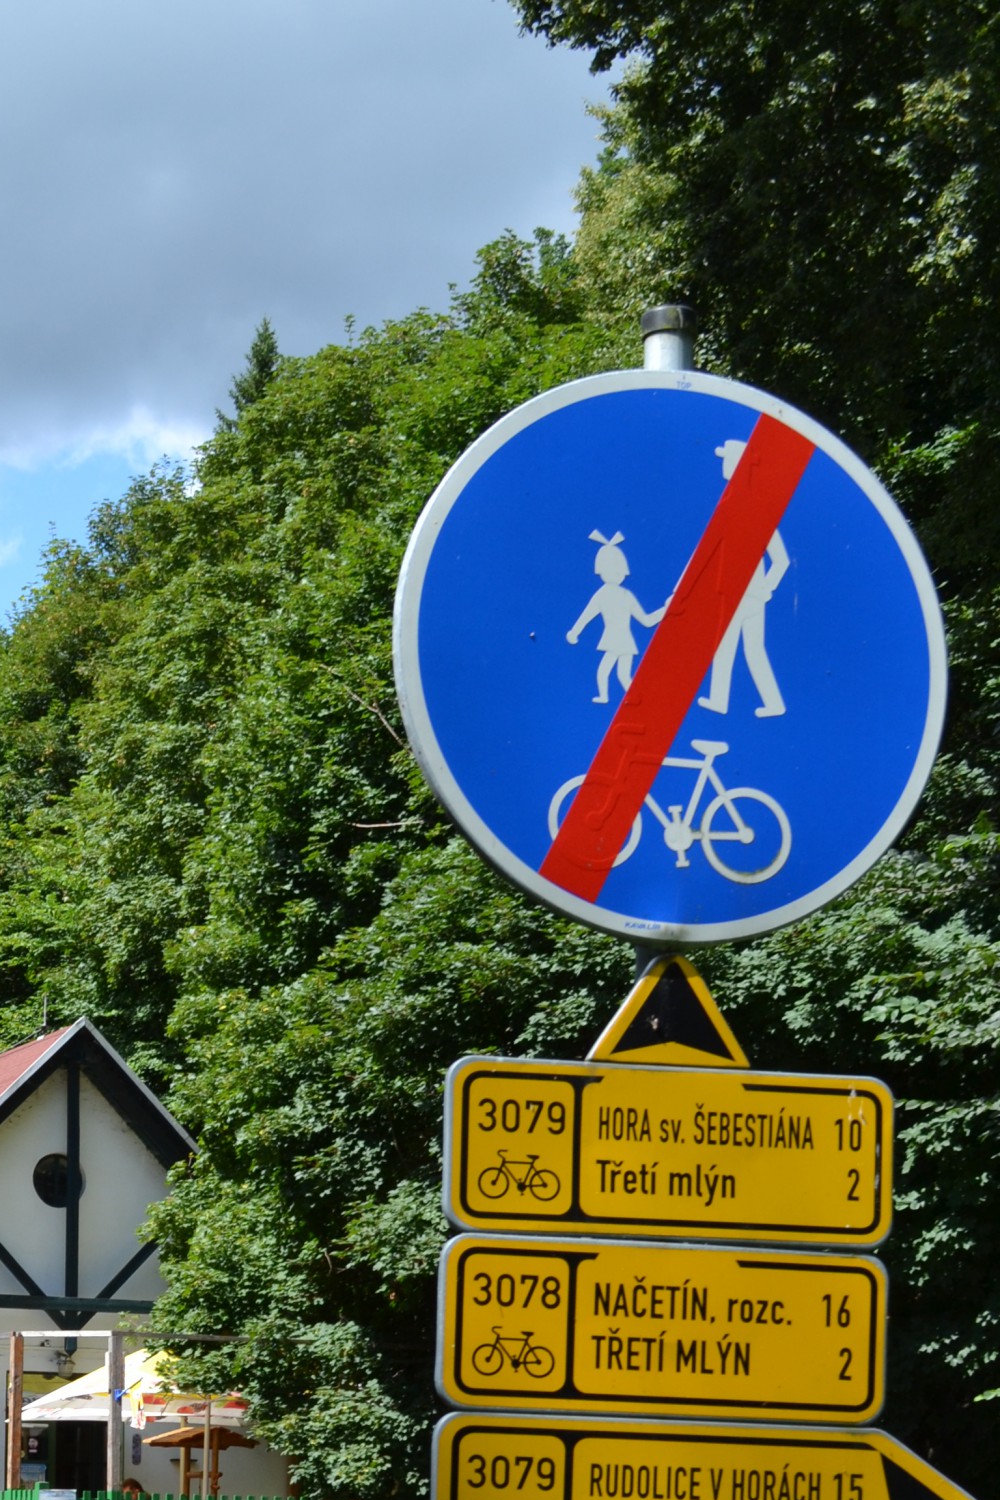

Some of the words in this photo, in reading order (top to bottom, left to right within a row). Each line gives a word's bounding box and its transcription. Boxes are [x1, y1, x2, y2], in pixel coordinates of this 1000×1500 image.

[478, 1098, 566, 1135] 3079
[598, 1107, 651, 1142] HORA
[660, 1119, 686, 1144] sv.
[693, 1103, 814, 1149] ŠEBESTIÁNA
[835, 1118, 862, 1152] 10
[596, 1159, 658, 1195] Třetí
[668, 1164, 736, 1207] mlýn
[847, 1168, 860, 1202] 2
[473, 1272, 561, 1309] 3078
[594, 1276, 716, 1324] NAČETÍN,
[727, 1298, 792, 1326] rozc.
[822, 1294, 851, 1328] 16
[591, 1328, 666, 1372] TŘETÍ
[676, 1333, 751, 1376] MLÝN
[838, 1347, 853, 1381] 2
[466, 1454, 556, 1491] 3079
[589, 1463, 702, 1500] RUDOLICE
